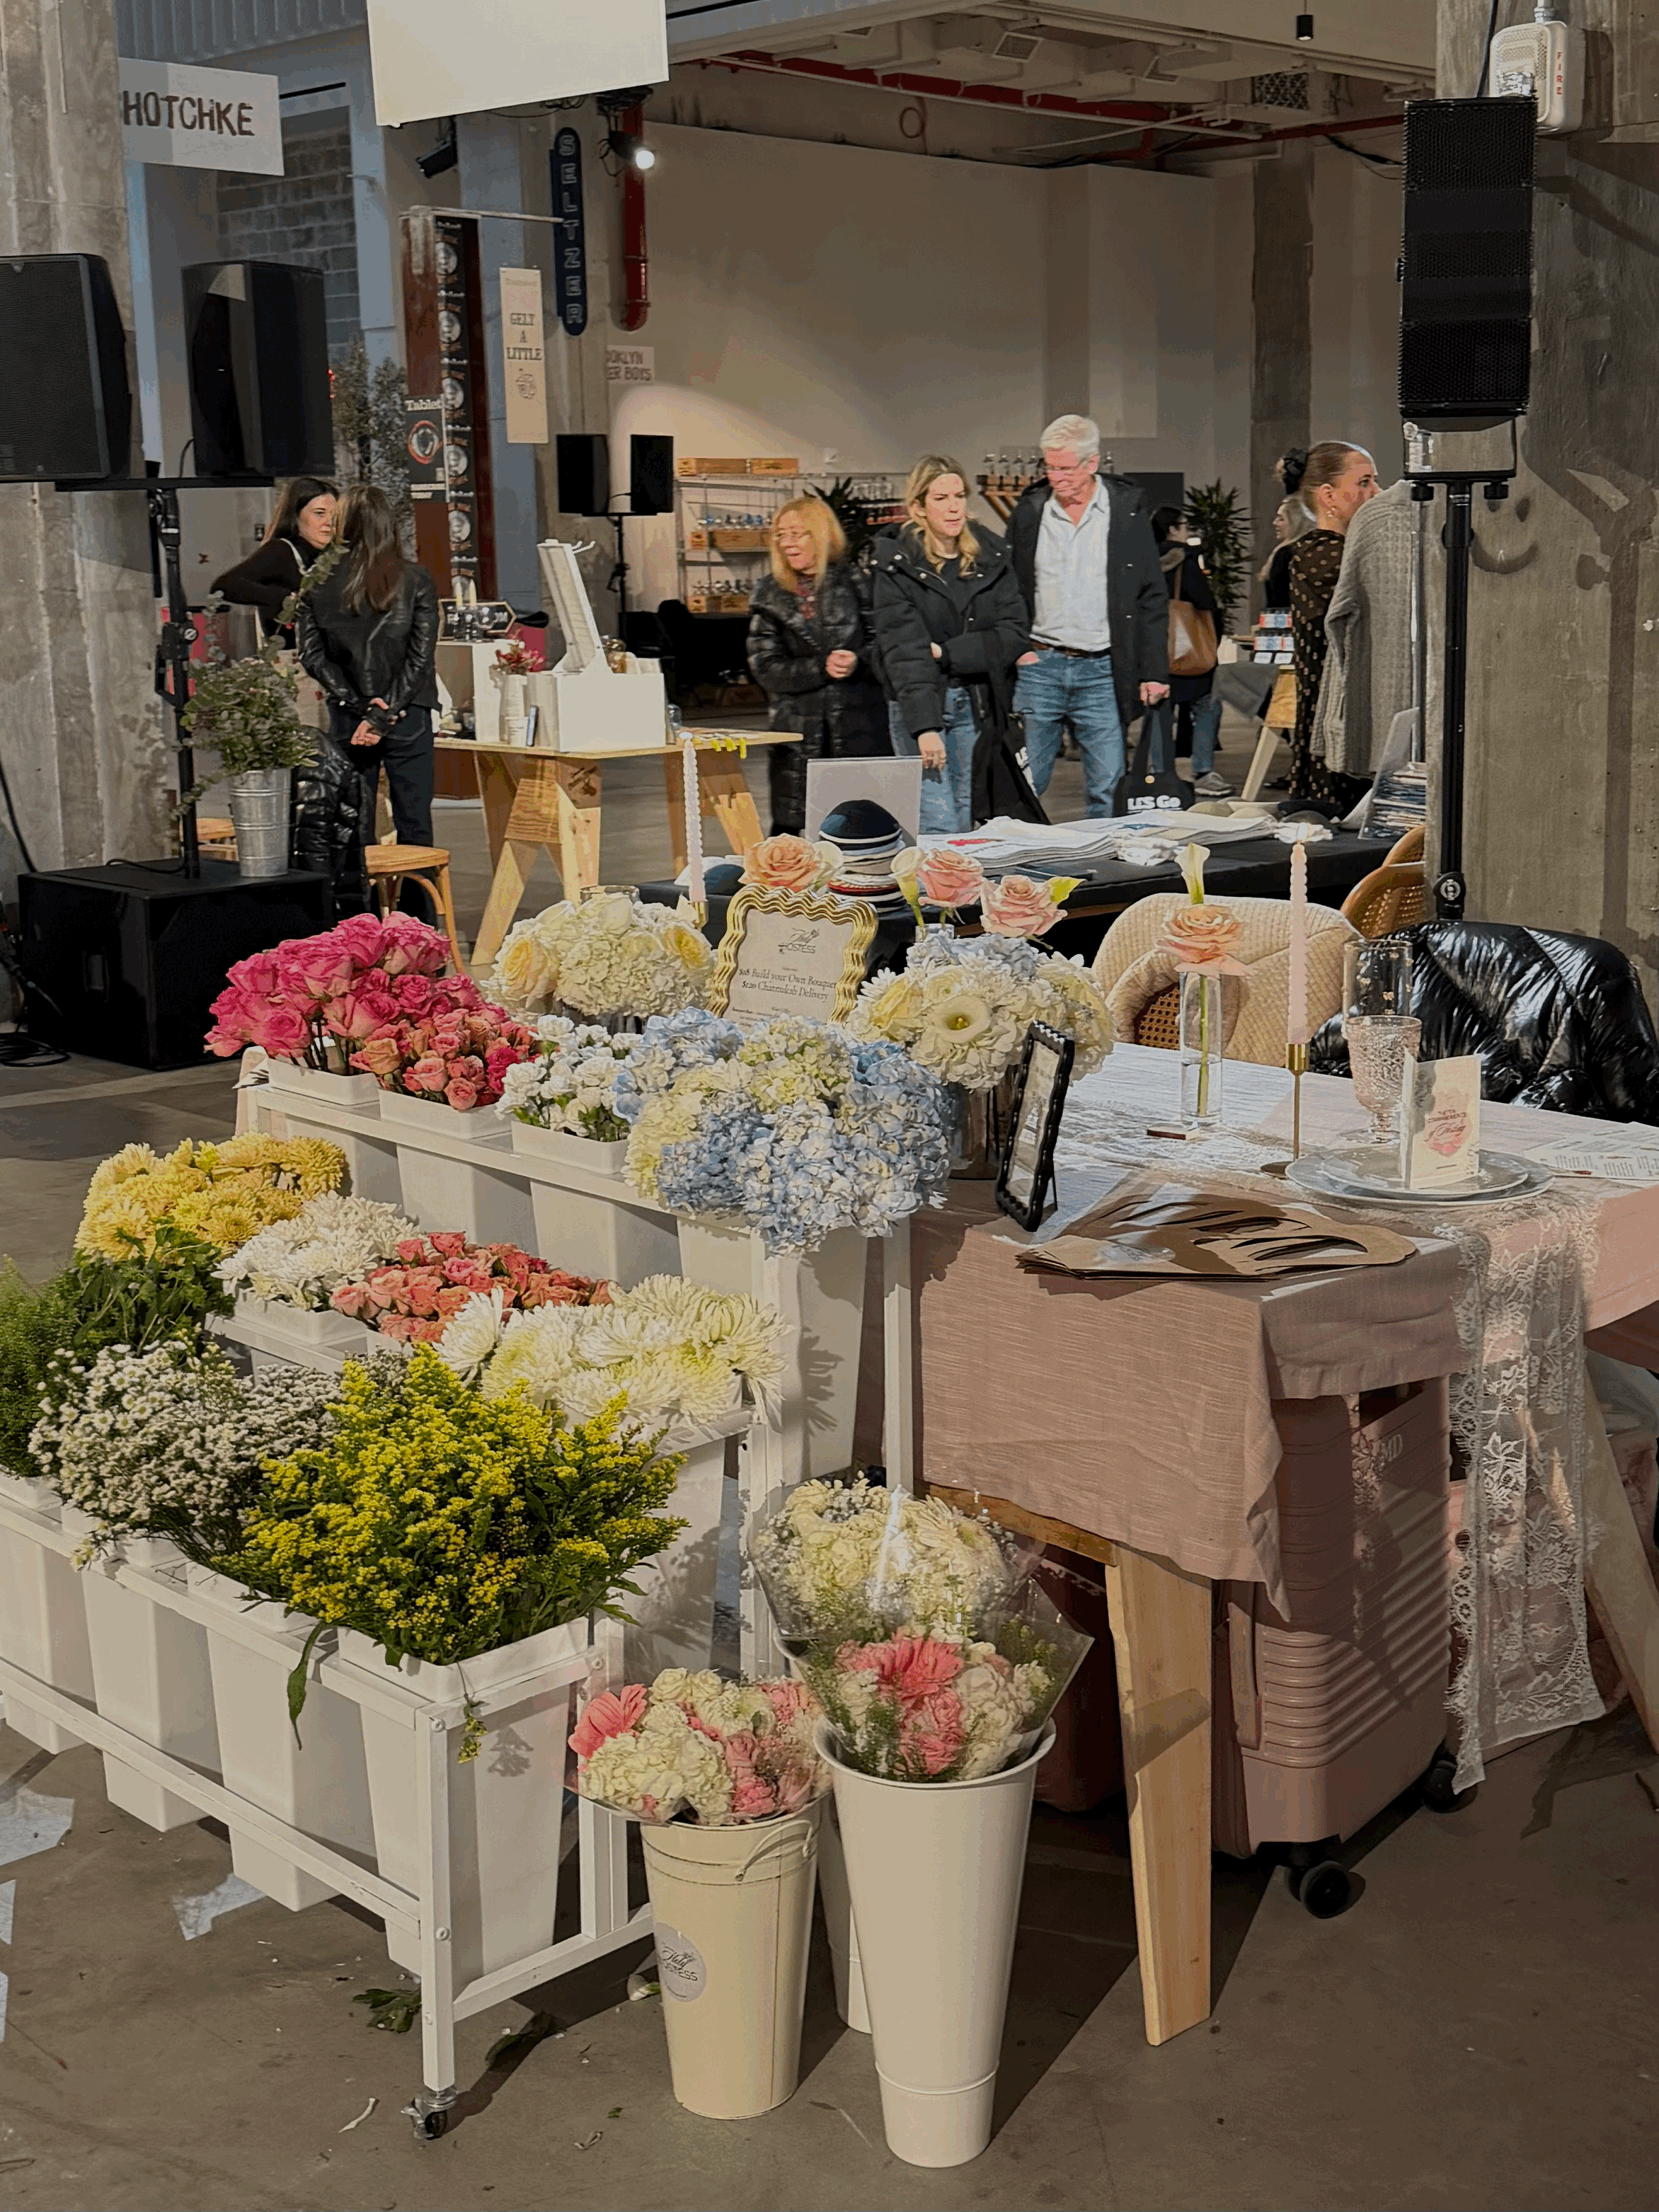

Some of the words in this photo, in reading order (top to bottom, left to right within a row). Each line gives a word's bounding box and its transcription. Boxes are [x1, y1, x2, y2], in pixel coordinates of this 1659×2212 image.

[119, 90, 256, 137] HOTCHKE
[558, 134, 583, 325] SELTZER
[510, 312, 536, 326] GELT
[519, 329, 532, 343] A
[506, 347, 543, 361] LITTLE
[607, 365, 621, 380] ER
[624, 366, 652, 382] BOYS
[1127, 796, 1156, 810] LES
[1156, 794, 1181, 809] Go
[752, 968, 771, 979] Build
[788, 973, 806, 984] Own
[798, 986, 830, 1004] Delivery
